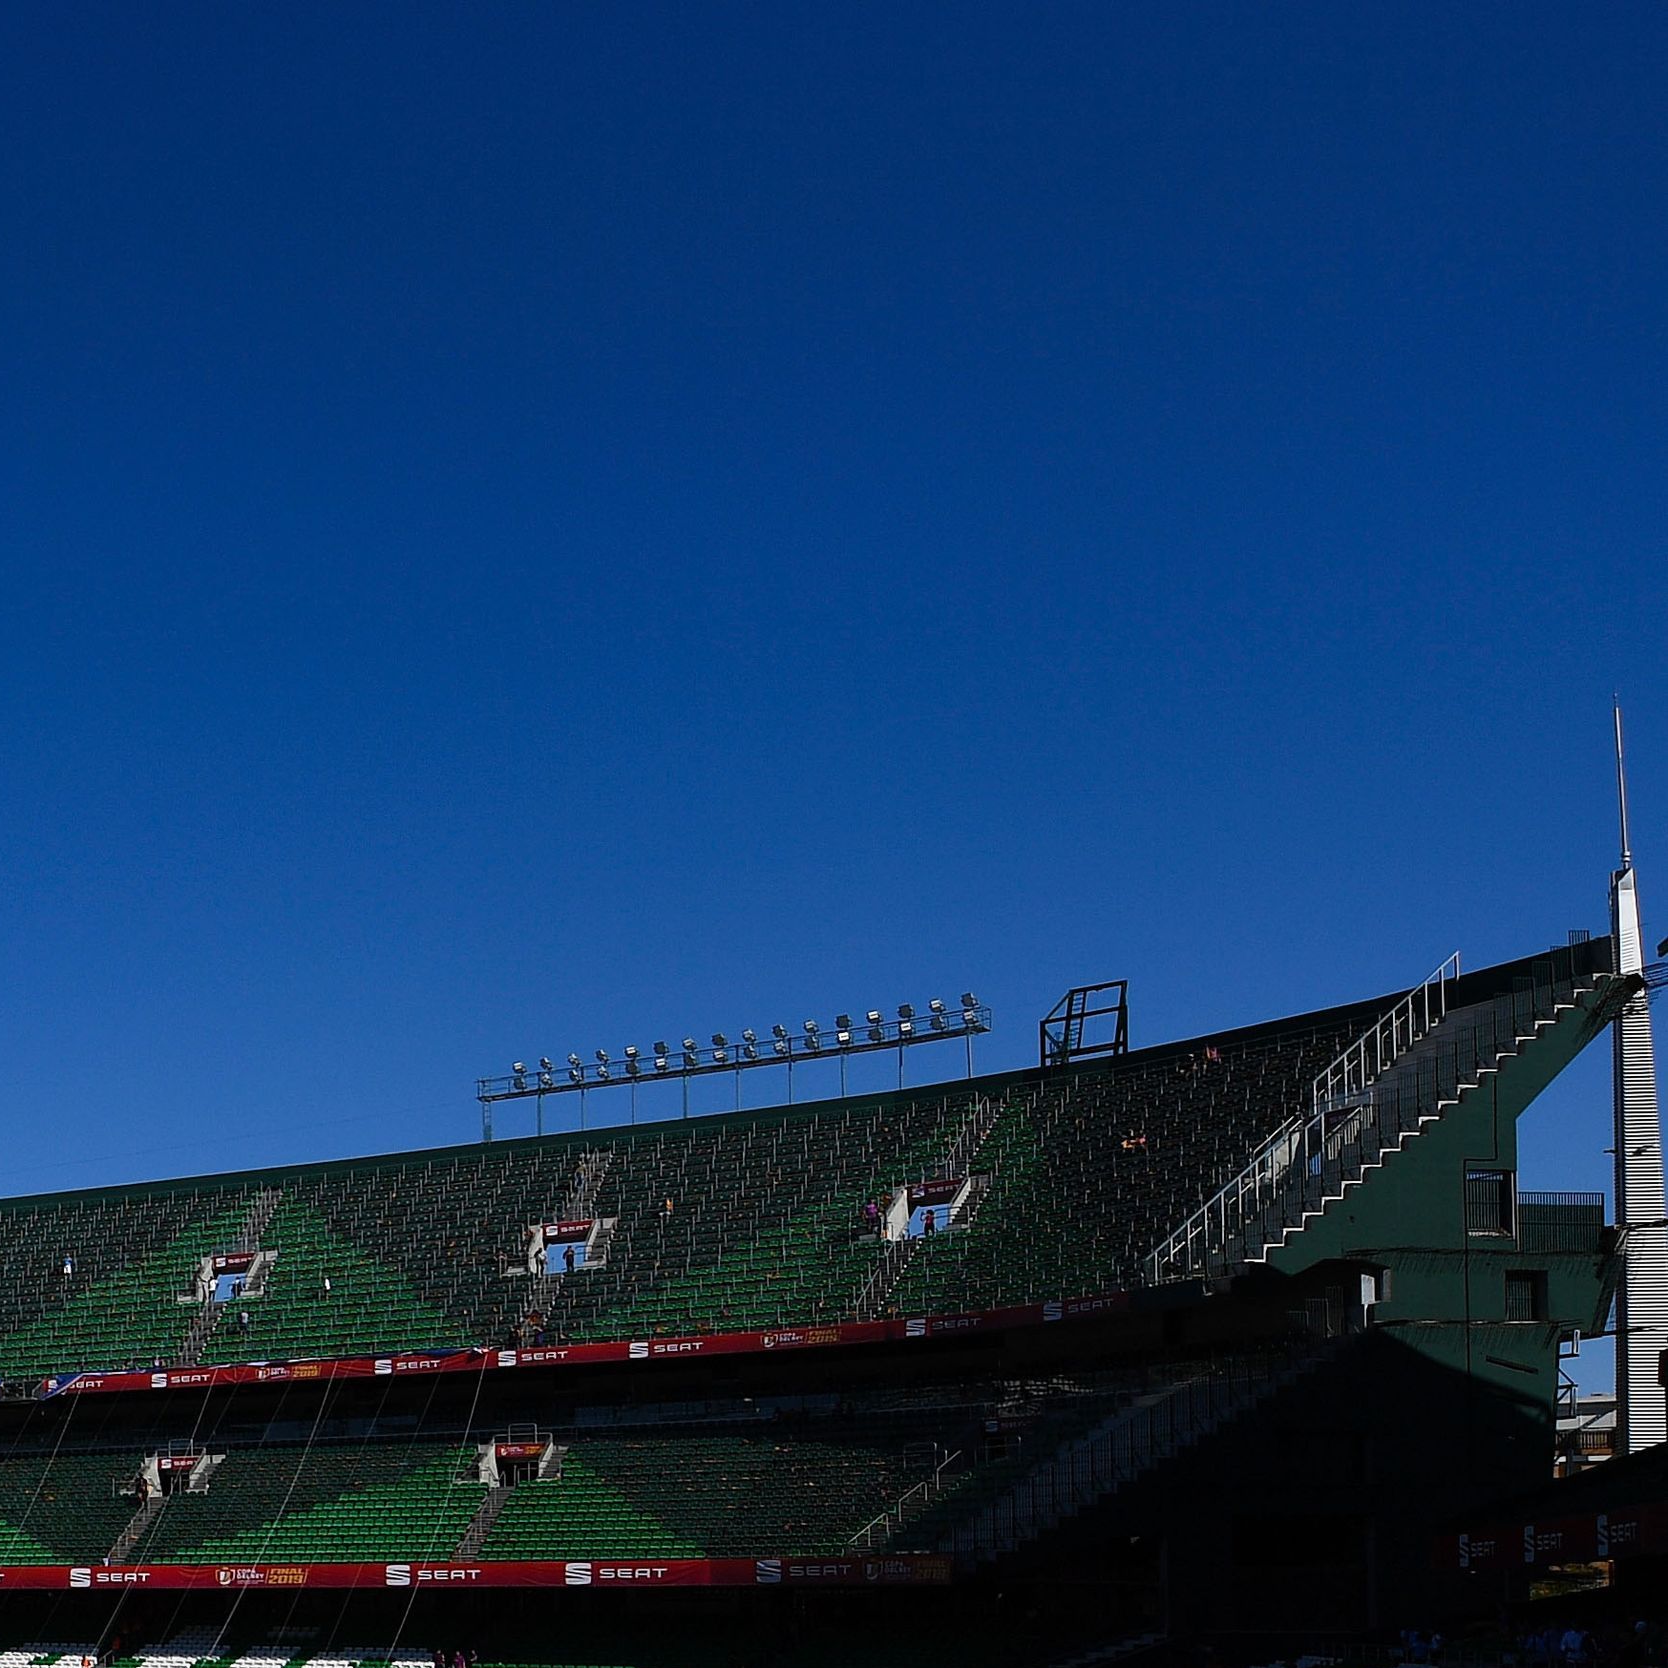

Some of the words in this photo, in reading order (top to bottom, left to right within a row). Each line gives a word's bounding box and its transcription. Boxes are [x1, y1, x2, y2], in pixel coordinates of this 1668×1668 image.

[932, 1318, 981, 1329] SEAT
[654, 1343, 703, 1352] SEAT
[522, 1351, 567, 1361] SEAT
[397, 1360, 440, 1369] SEAT
[171, 1375, 210, 1383] SEAT
[1610, 1522, 1638, 1543] SEAT
[1537, 1533, 1563, 1550] SEAT
[1471, 1541, 1496, 1559] SEAT
[418, 1570, 480, 1579] SEAT
[600, 1569, 667, 1578] SEAT
[789, 1565, 851, 1576] SEAT
[97, 1573, 150, 1581] SEAT
[268, 1574, 304, 1584] 2019
